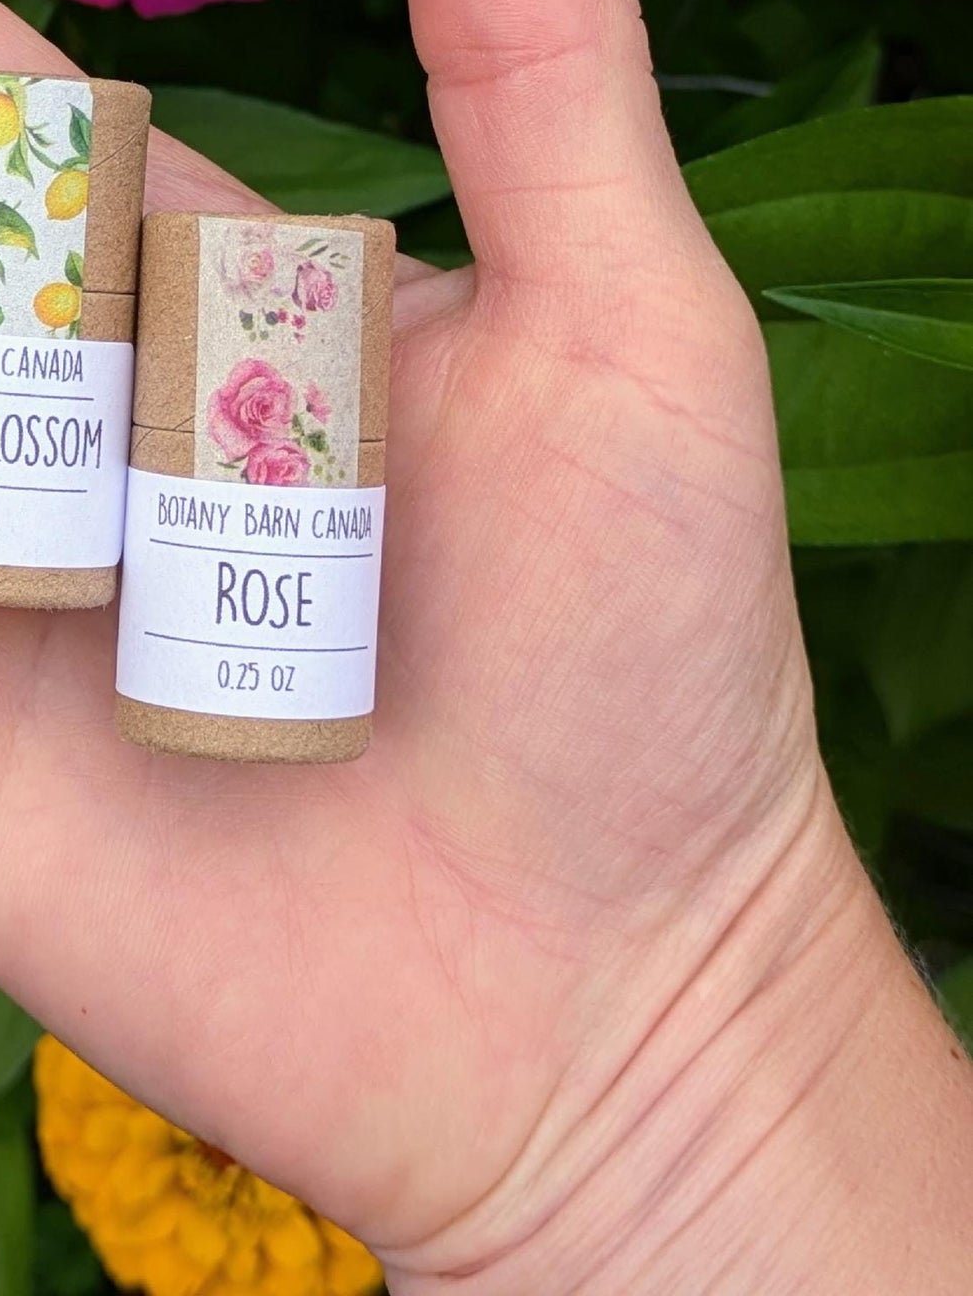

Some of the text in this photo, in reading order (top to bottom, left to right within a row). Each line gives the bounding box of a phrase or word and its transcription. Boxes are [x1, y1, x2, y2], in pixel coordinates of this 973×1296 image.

[1, 346, 84, 382] CANADA
[158, 493, 372, 540] BOTANY BARN CANADA
[216, 562, 313, 629] ROSE
[218, 661, 295, 692] 0.25 OZ
